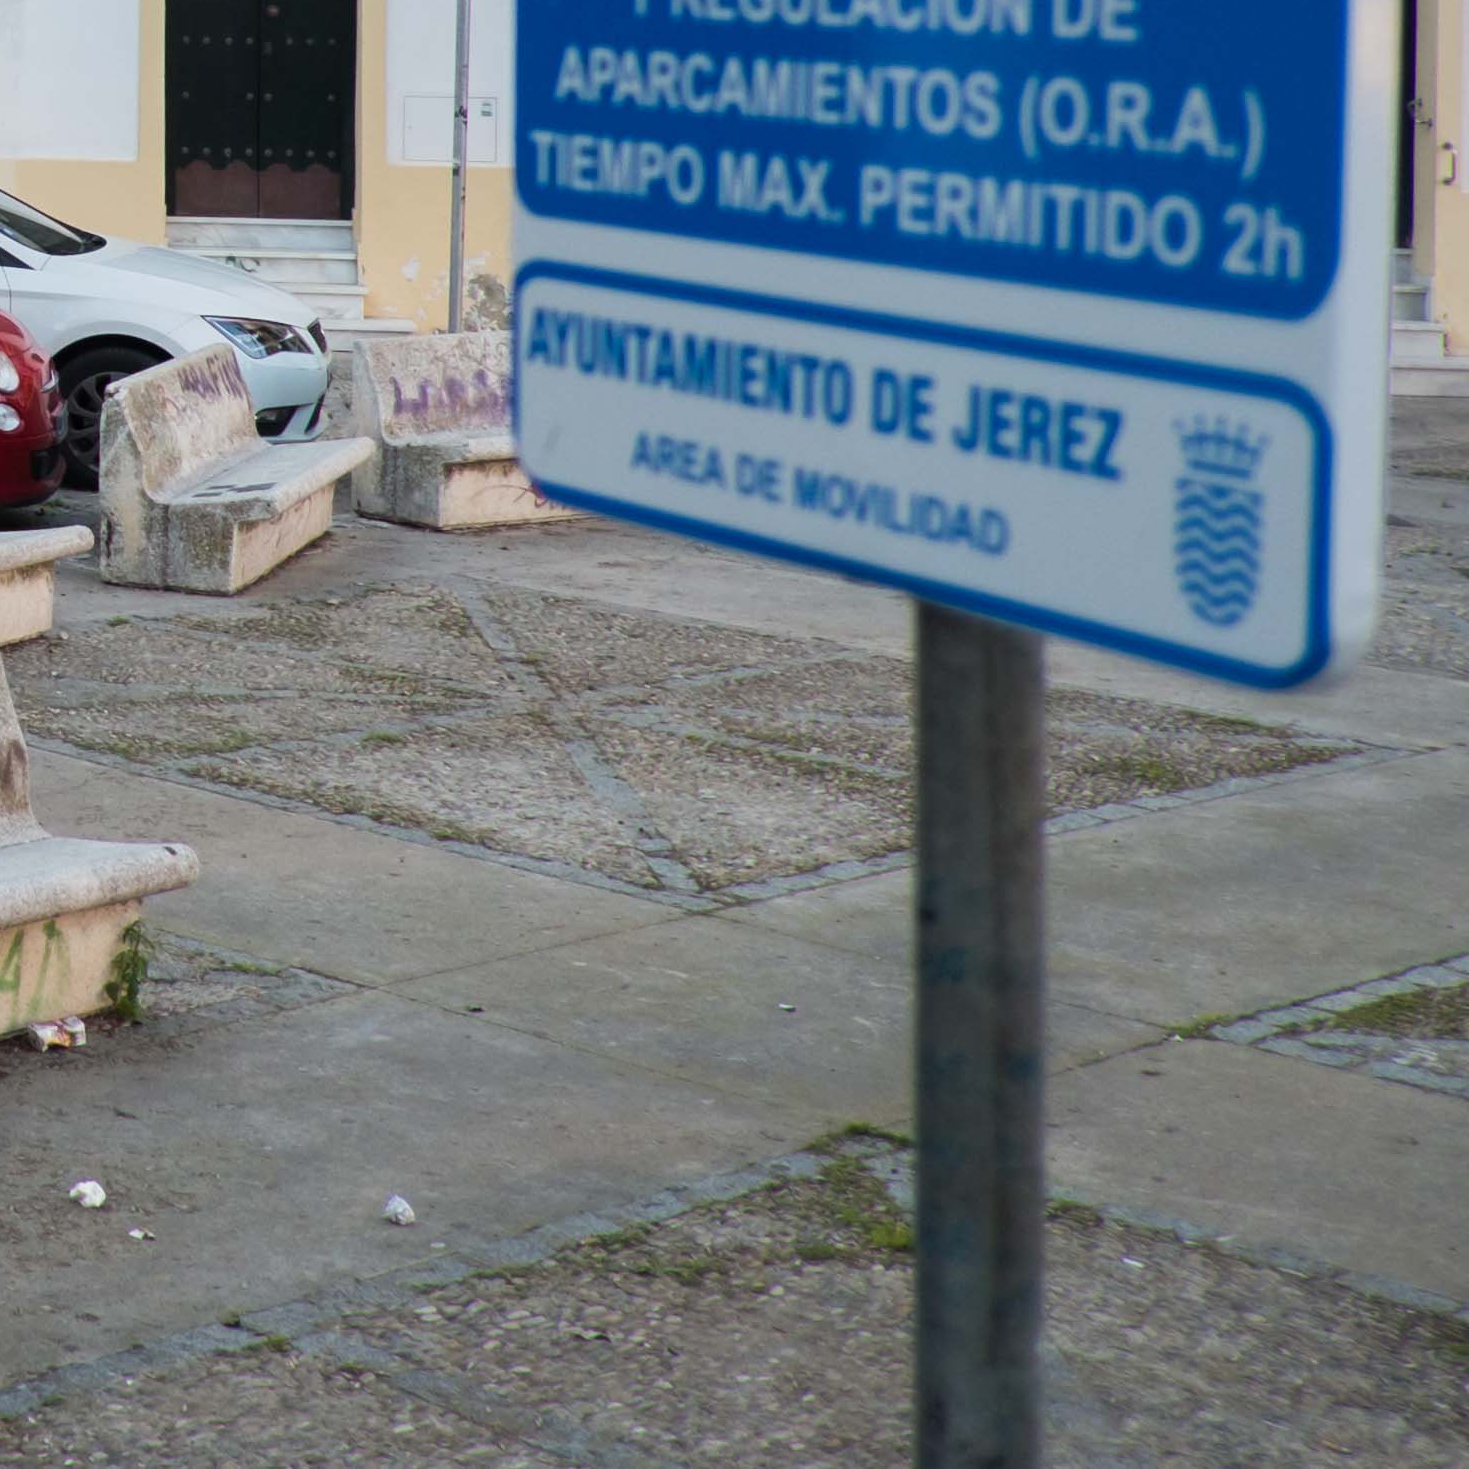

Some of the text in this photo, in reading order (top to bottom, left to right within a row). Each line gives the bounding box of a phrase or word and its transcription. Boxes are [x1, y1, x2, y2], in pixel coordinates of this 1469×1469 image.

[554, 45, 1002, 140] APARCAMIENTOS
[530, 129, 1305, 280] TIEMPO MAX. PERMITIDO 2h
[528, 307, 855, 427] AYUNTAMIENTO
[871, 367, 935, 444] DE
[953, 385, 1124, 482] JEREZ
[631, 430, 1012, 556] AREA DE MOVILIDAD
